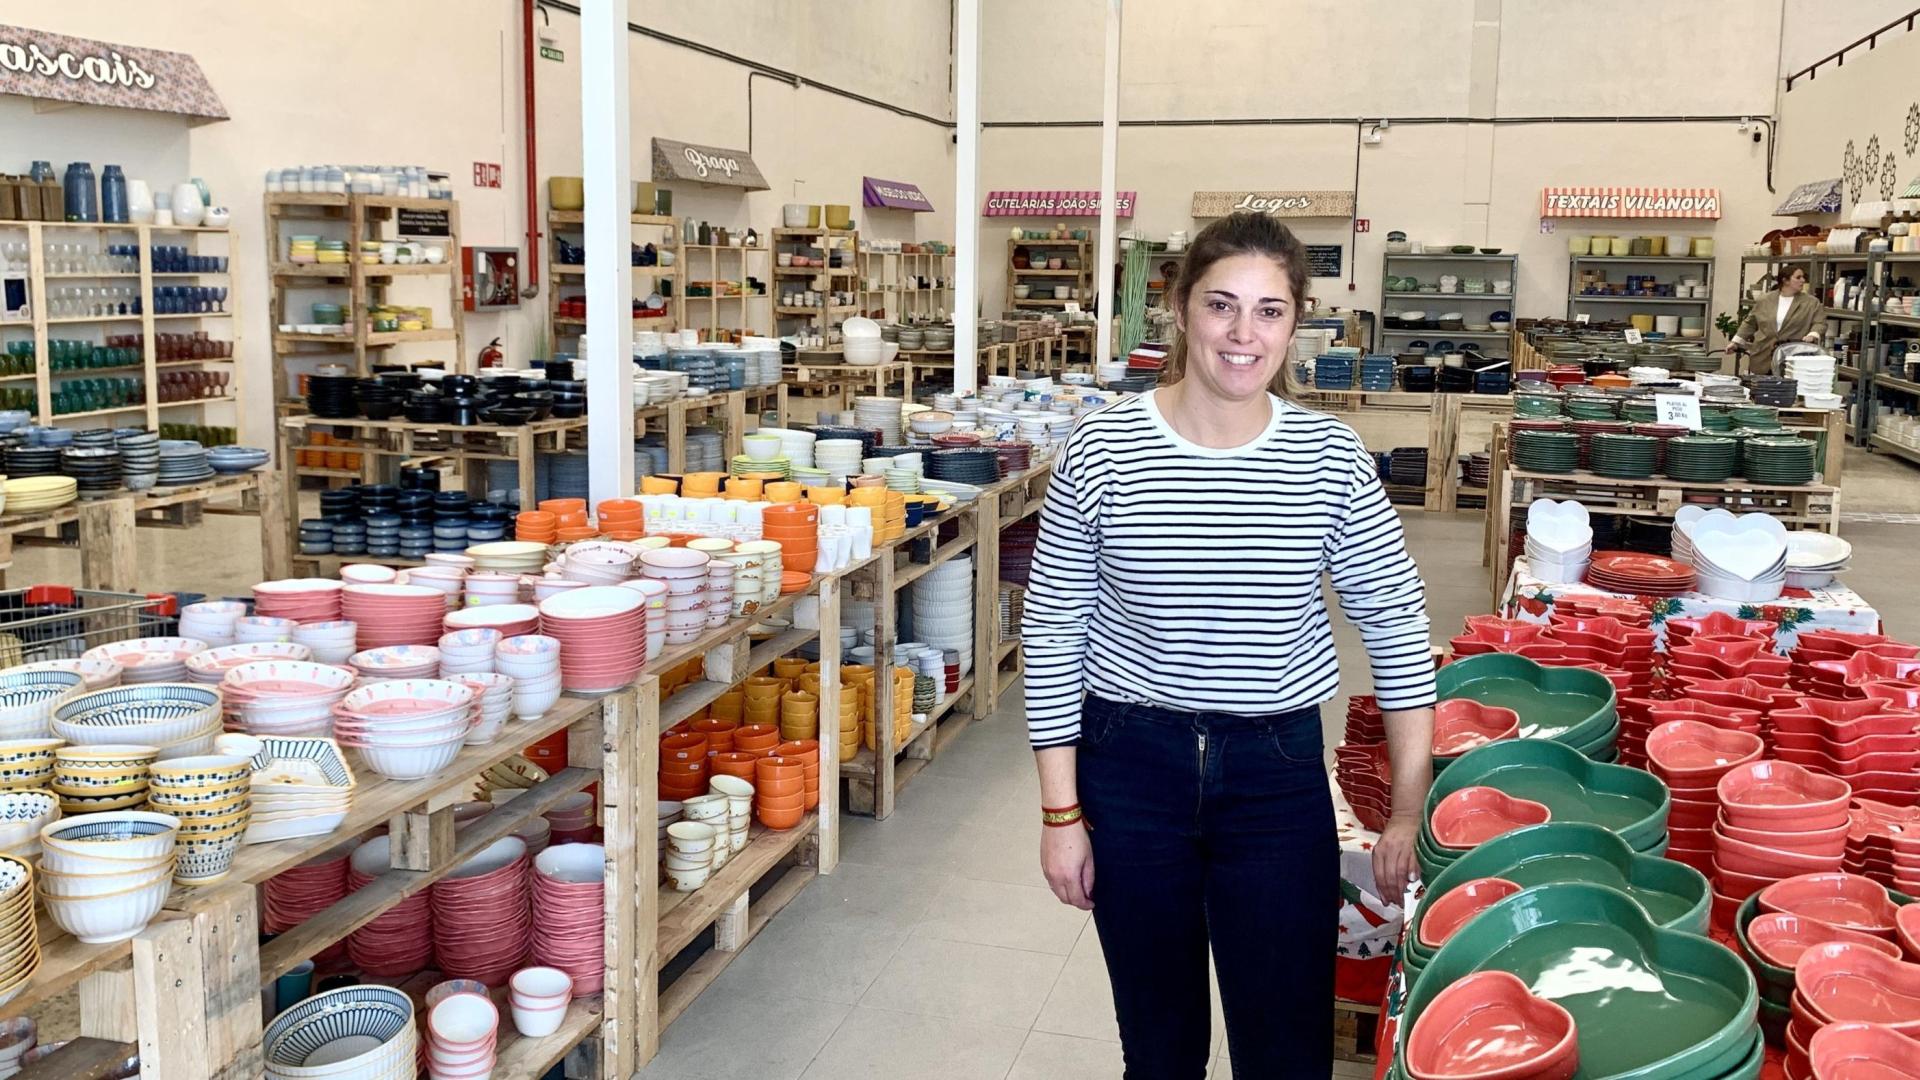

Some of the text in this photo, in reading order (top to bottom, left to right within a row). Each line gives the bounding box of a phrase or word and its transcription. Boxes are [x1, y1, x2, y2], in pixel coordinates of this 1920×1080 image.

[0, 43, 155, 90] ascais
[684, 147, 740, 178] Braga
[988, 197, 1130, 209] CUTELARIAS JOÃO SIES
[1234, 193, 1312, 214] Lagos
[1547, 195, 1717, 211] TEXTAIS VILANOVA
